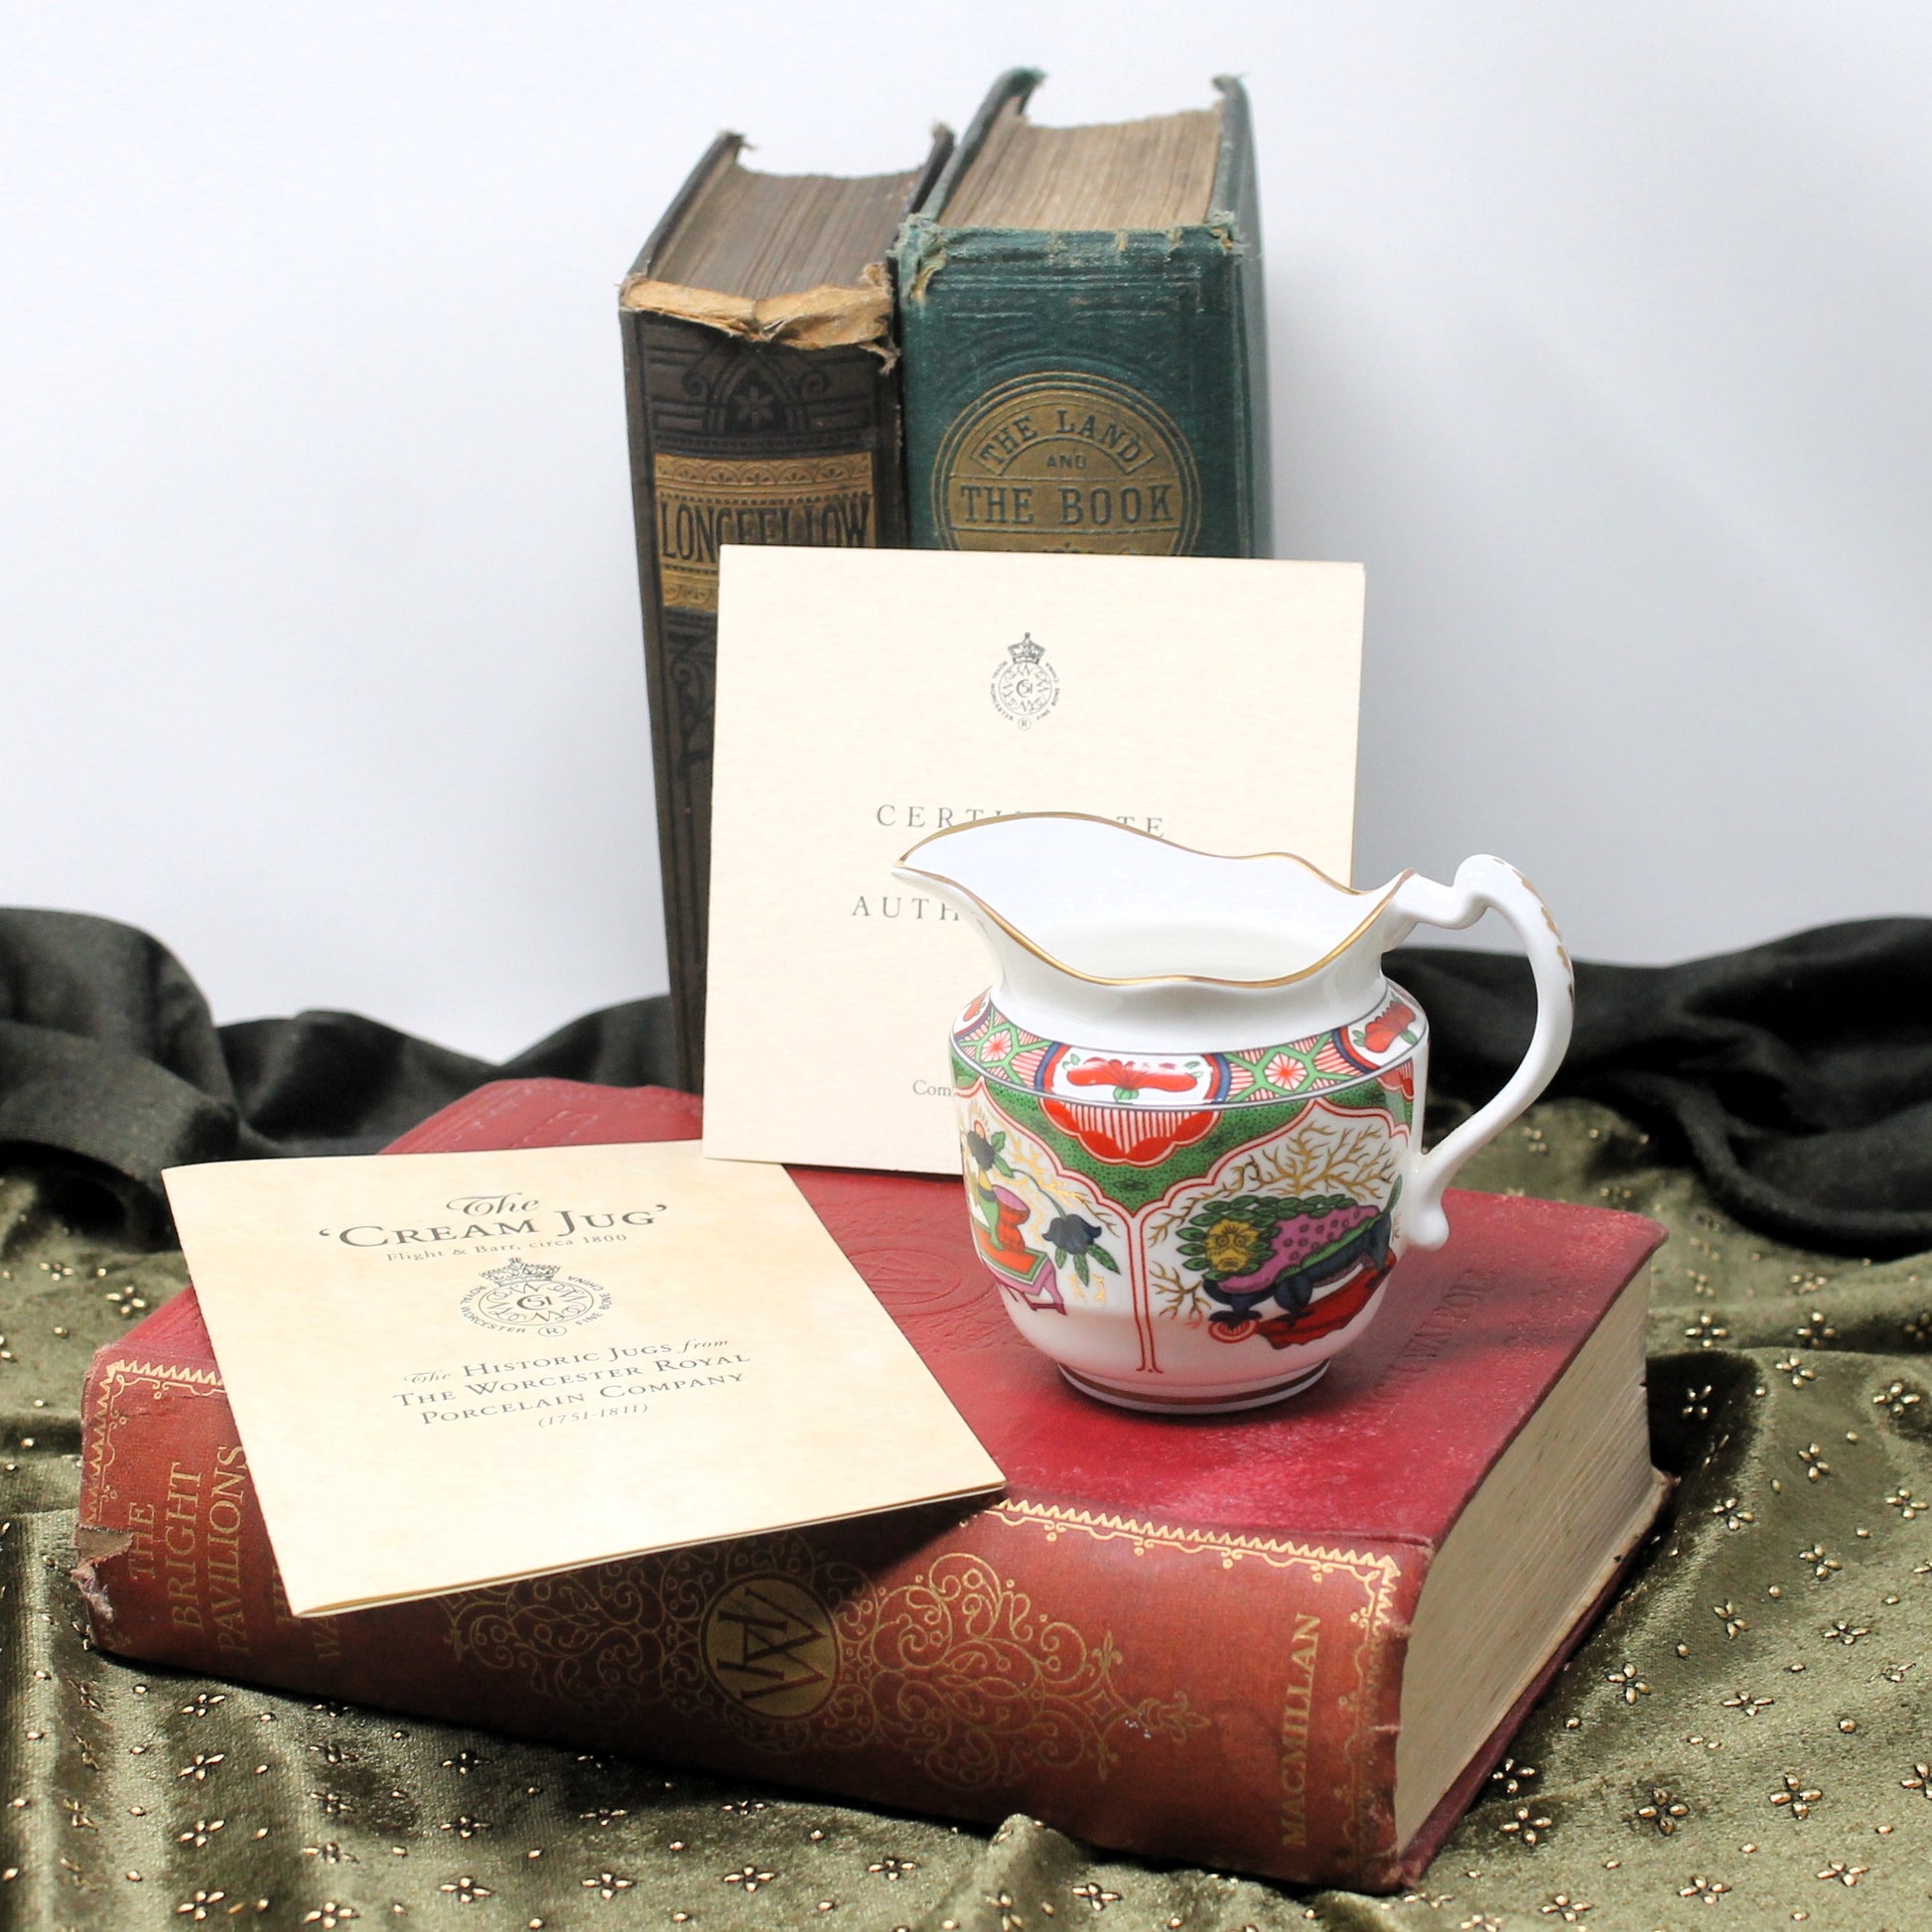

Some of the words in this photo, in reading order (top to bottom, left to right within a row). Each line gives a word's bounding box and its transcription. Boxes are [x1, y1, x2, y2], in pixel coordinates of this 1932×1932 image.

[980, 415, 1037, 465] THE
[1055, 409, 1143, 463] LAND
[1046, 454, 1088, 470] AND
[960, 484, 1035, 523] THE
[1058, 483, 1173, 525] BOOK
[446, 1191, 539, 1217] The
[386, 1248, 444, 1262] Flight
[476, 1243, 521, 1254] Barr,
[529, 1239, 574, 1249] circa
[583, 1234, 627, 1244] 1800
[575, 1311, 604, 1326] FINE
[392, 1390, 457, 1407] THE
[465, 1366, 643, 1395] WORCESTER
[652, 1353, 751, 1373] ROYAL
[403, 1369, 452, 1384] The
[461, 1352, 600, 1377] HISTORIC
[608, 1343, 672, 1363] JUGS
[677, 1338, 729, 1354] from
[421, 1392, 585, 1425] PORCELAIN
[600, 1373, 744, 1398] COMPANY
[538, 1404, 648, 1429] (1751-1811)
[127, 1502, 156, 1579] THE
[165, 1460, 204, 1633] BRIGHT
[207, 1445, 249, 1653] PAVILIONS
[1281, 1611, 1320, 1848] MACMILLAN
